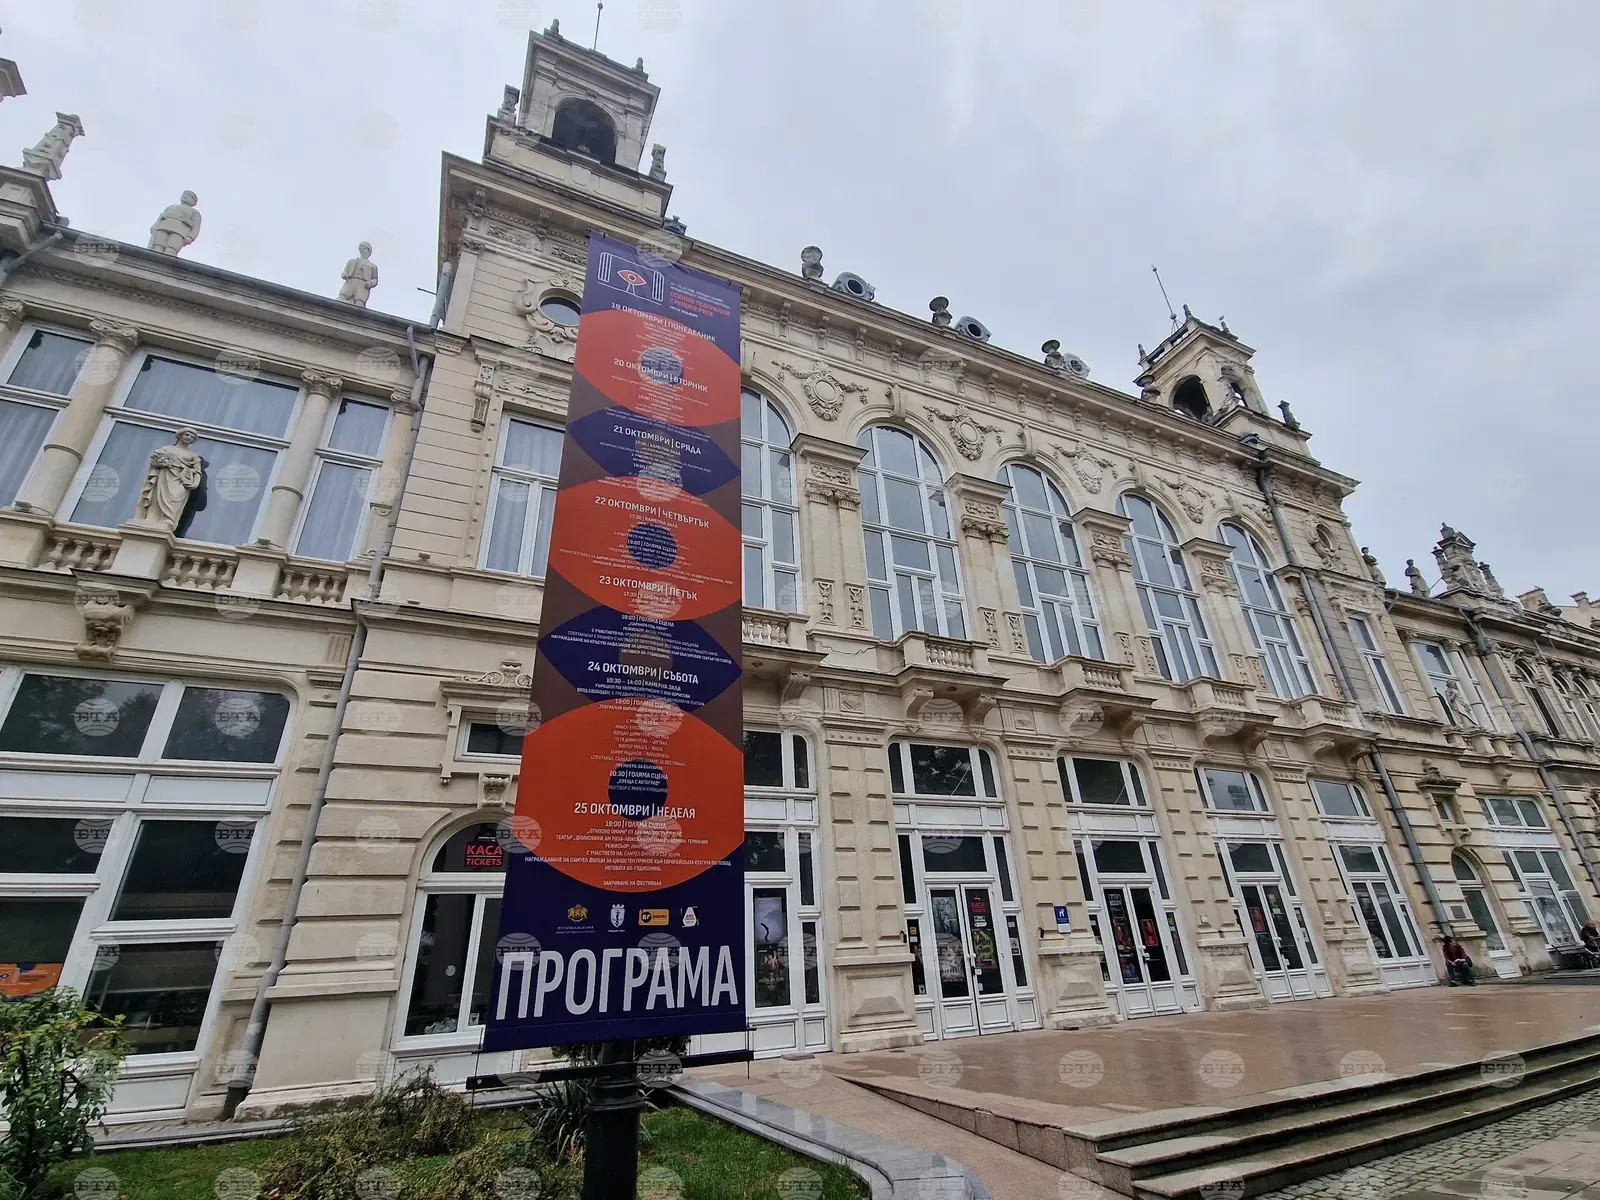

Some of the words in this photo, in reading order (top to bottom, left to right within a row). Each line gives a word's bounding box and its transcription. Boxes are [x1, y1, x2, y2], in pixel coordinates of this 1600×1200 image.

[611, 302, 620, 310] 19
[622, 305, 662, 324] ОКТОМВРИ
[668, 321, 715, 342] ПОНЕДЕЛНИК
[613, 358, 624, 366] 20
[625, 361, 668, 380] ОКТОМВРИ
[673, 375, 707, 392] ВТОРНИК
[613, 424, 623, 433] 21
[624, 427, 670, 445] ОКТОМВРИ
[675, 441, 701, 455] СРЯДА
[595, 495, 606, 505] 22
[608, 498, 656, 516] ОКТОМВРИ
[662, 510, 709, 528] ЧЕТВЪРТЪК
[599, 575, 610, 585] 23
[612, 577, 663, 594] ОКТОМВРИ
[669, 587, 697, 601] ПЕТЪК
[587, 660, 600, 671] 24
[602, 662, 656, 677] ОКТОМВРИ
[663, 670, 698, 684] СЪБОТА
[574, 802, 587, 813] 25
[590, 803, 649, 816] ОКТОМВРИ
[656, 806, 695, 819] НЕДЕЛЯ
[466, 845, 502, 855] КАСА
[466, 858, 502, 866] TICKETS
[496, 945, 738, 1020] ПРОГРАМА
